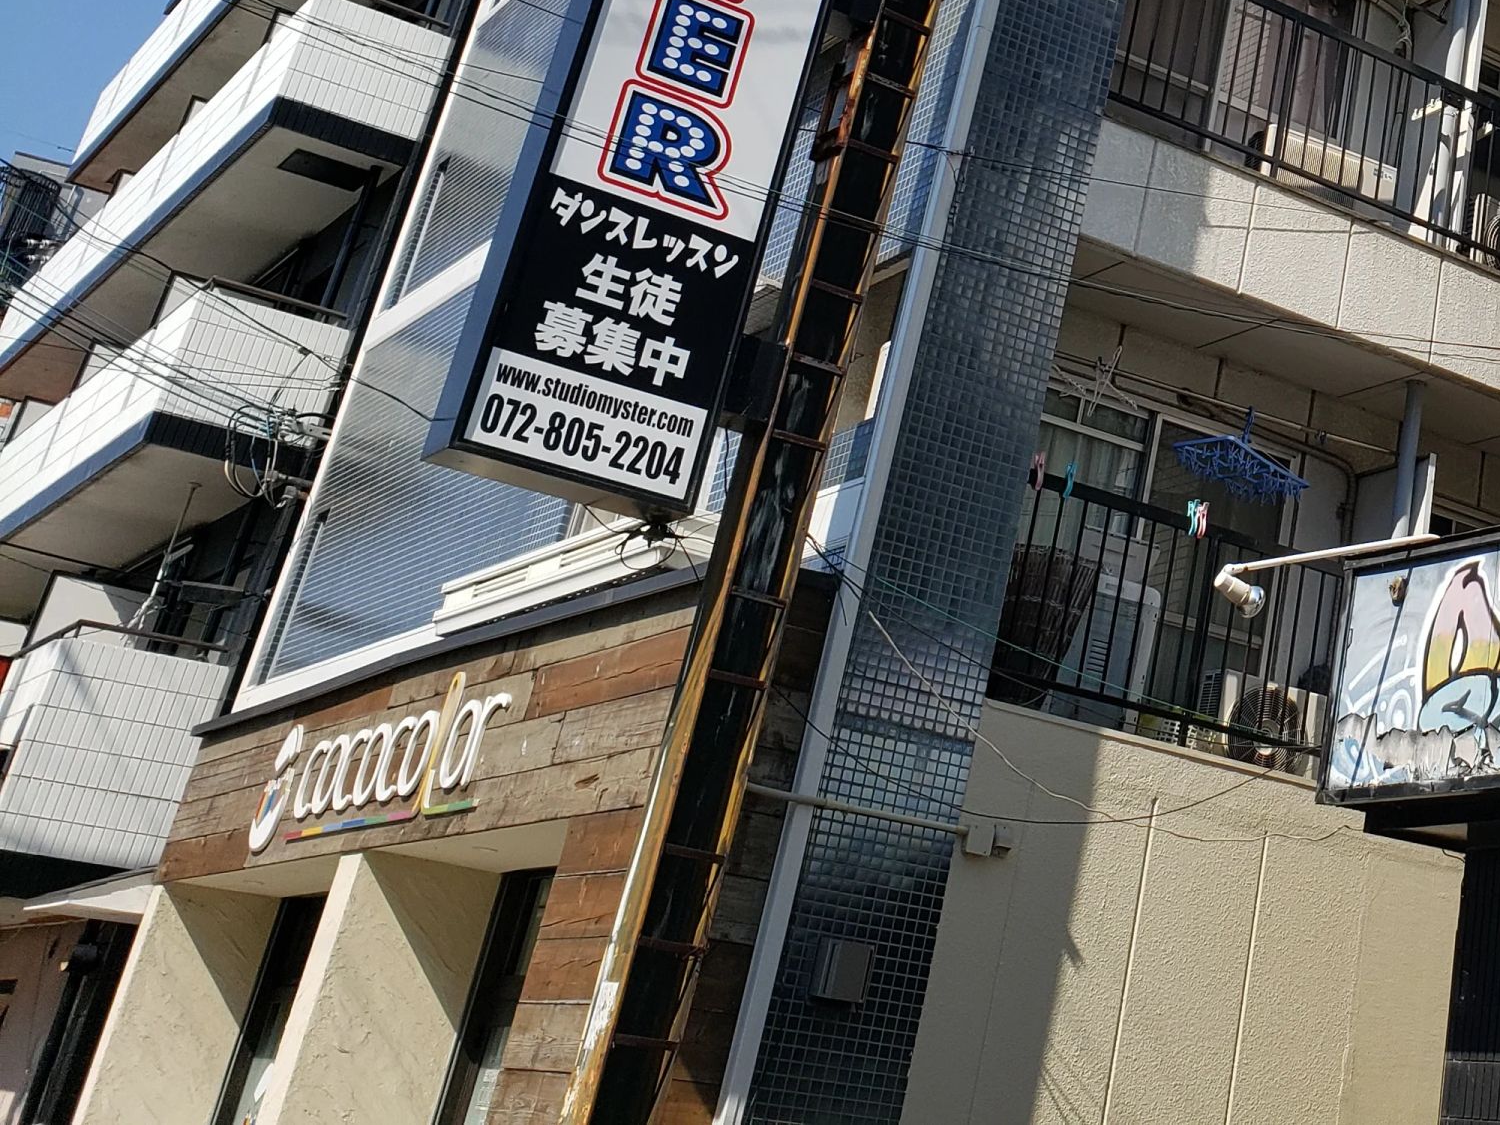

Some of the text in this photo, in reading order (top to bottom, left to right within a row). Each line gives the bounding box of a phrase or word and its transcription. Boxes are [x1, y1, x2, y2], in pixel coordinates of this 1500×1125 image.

[550, 187, 739, 278] ダンスレッスン
[575, 253, 682, 326] 生徒
[534, 300, 690, 386] 募集中
[480, 393, 686, 484] 072-805-2204
[496, 363, 694, 438] www.studiomyster.com
